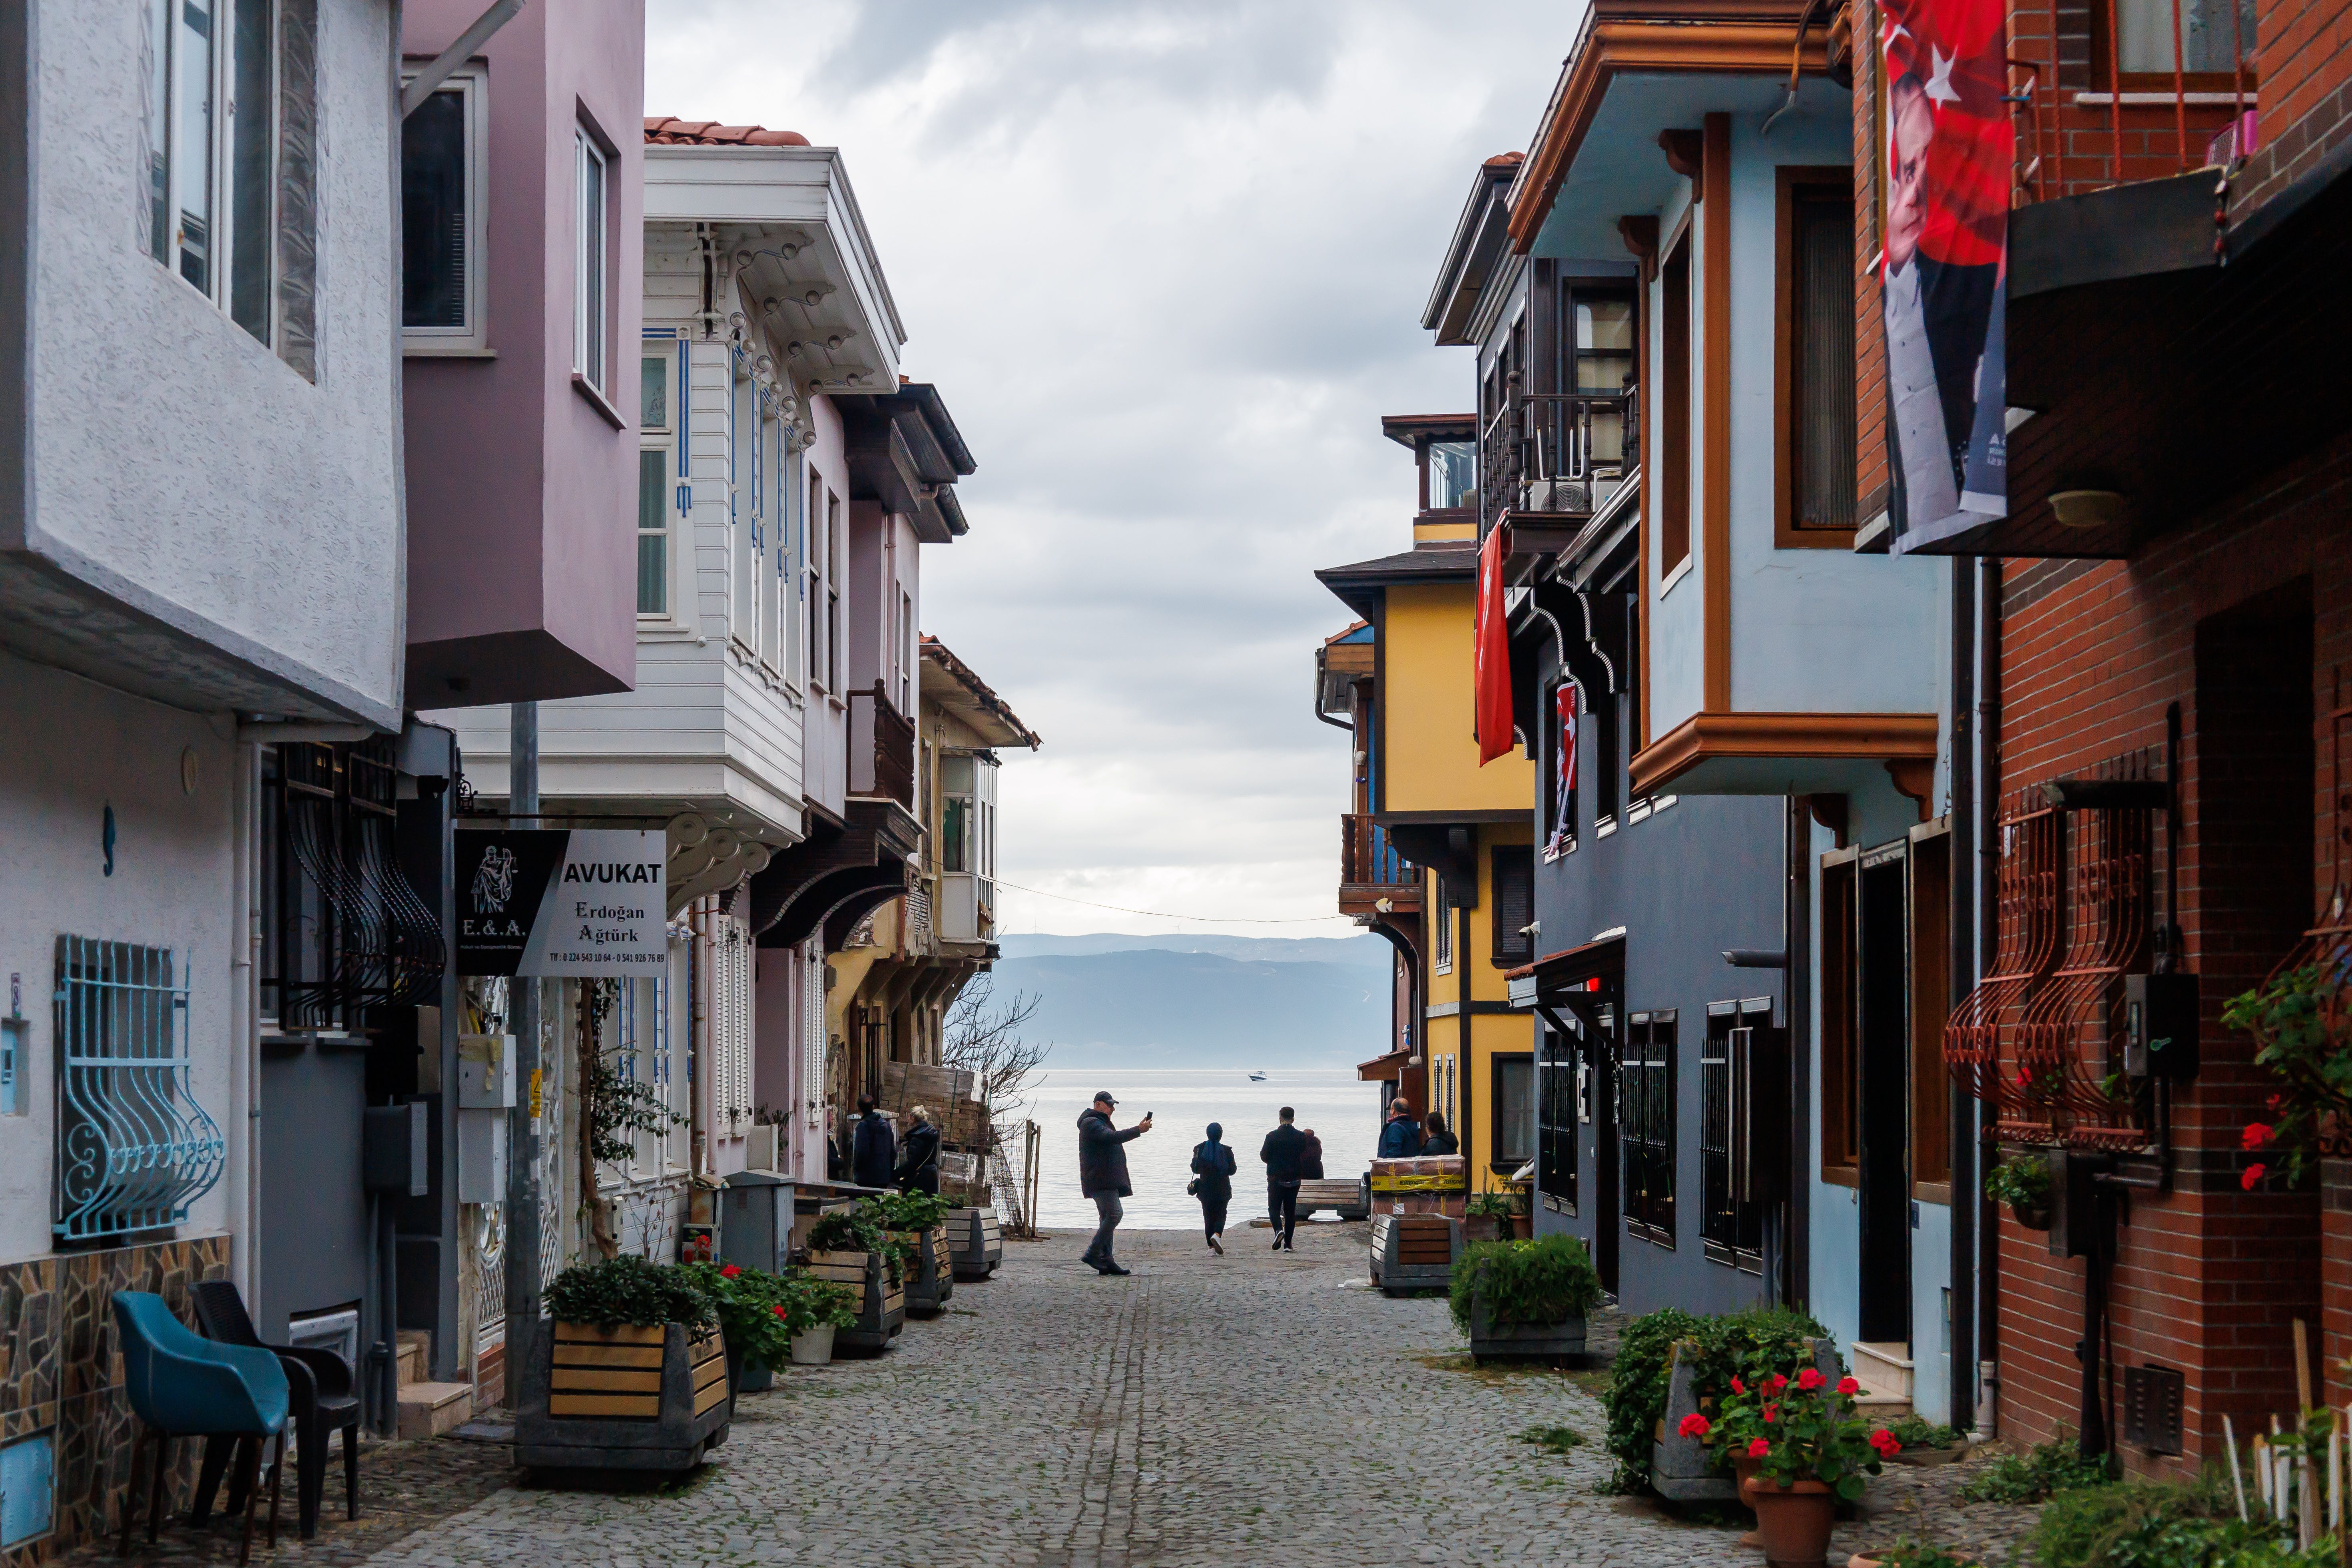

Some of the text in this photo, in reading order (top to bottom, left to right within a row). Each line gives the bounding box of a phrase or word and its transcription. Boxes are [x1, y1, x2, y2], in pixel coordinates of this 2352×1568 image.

[564, 863, 662, 883] AVUKAT
[575, 902, 644, 922] Erdoğan
[578, 924, 639, 945] Ağtürk
[563, 953, 567, 962] 0
[568, 953, 580, 962] 224
[581, 953, 592, 962] 543
[594, 953, 602, 962] 10
[603, 953, 611, 962] 64
[616, 954, 620, 962] 0
[622, 954, 633, 962] 541
[635, 954, 646, 962] 926
[648, 954, 656, 962] 76
[657, 954, 664, 962] 89
